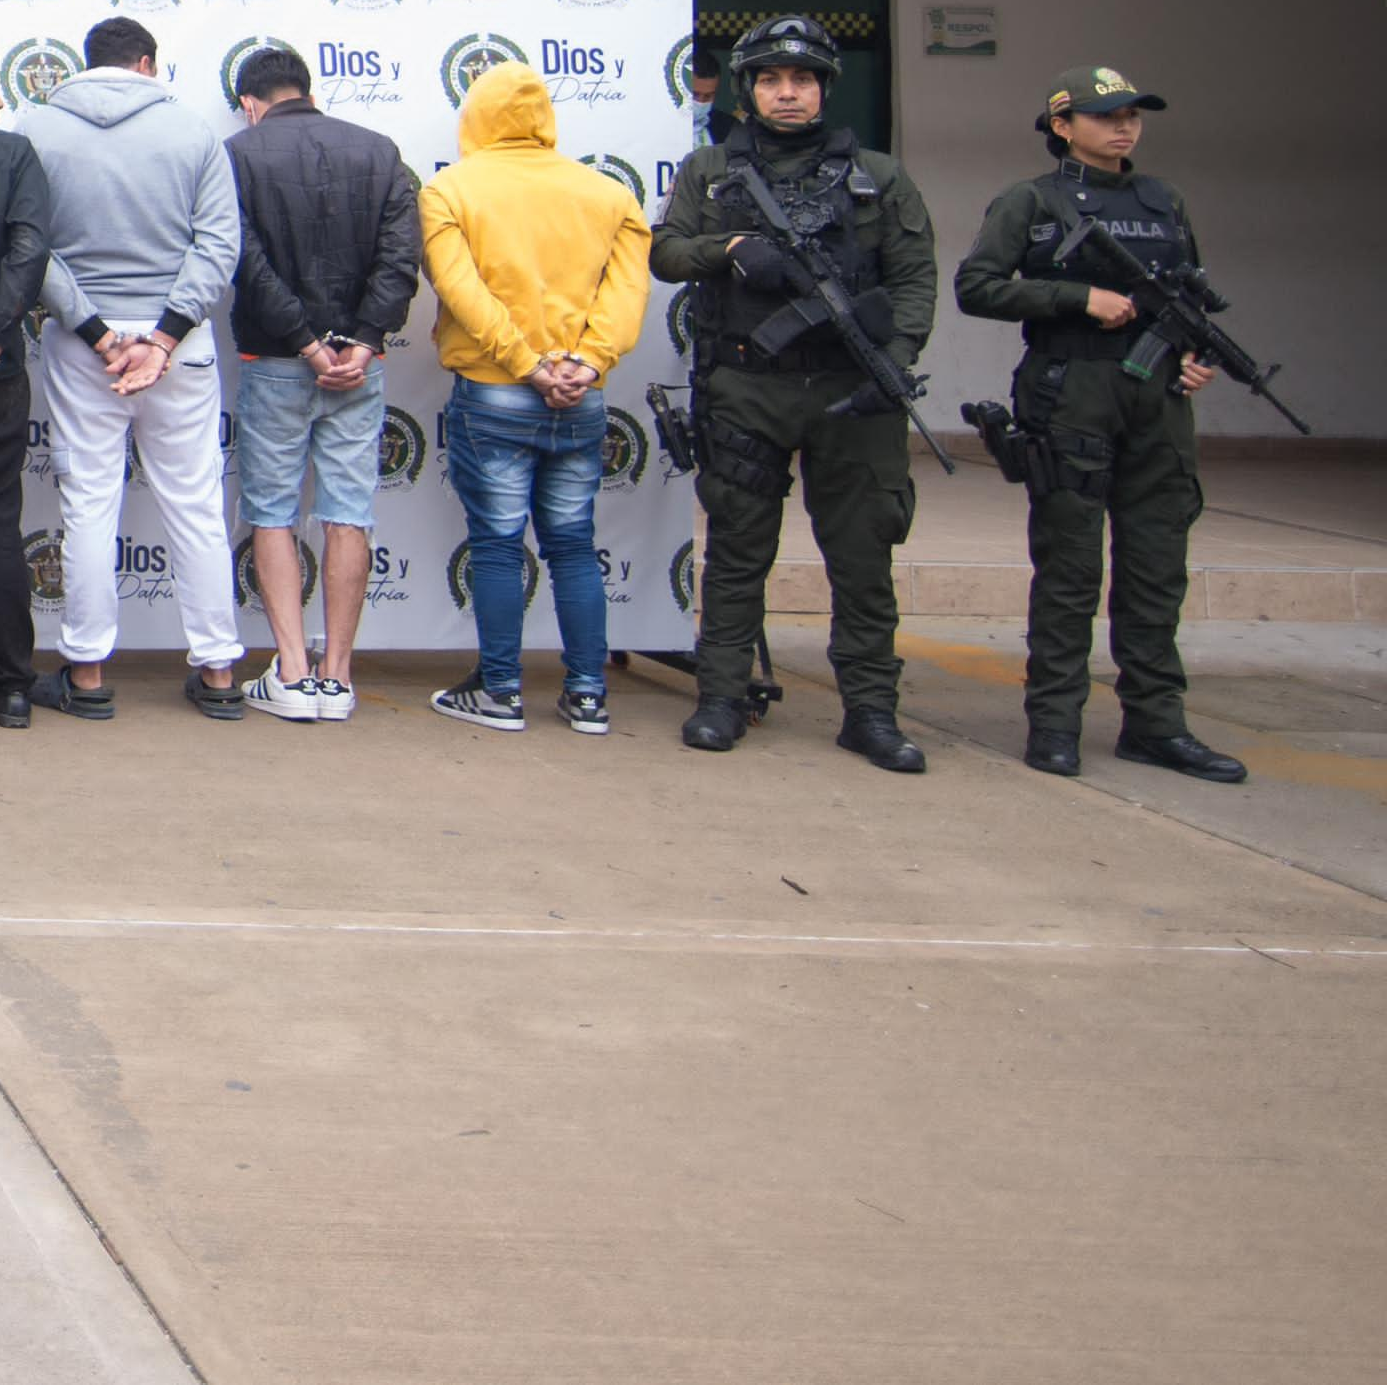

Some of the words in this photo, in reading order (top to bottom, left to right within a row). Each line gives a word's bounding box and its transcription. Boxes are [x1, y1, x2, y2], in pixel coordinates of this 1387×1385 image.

[168, 64, 176, 82] y
[319, 43, 381, 77] Dios
[391, 63, 400, 80] y
[542, 39, 605, 75] Dios
[615, 60, 624, 78] y
[323, 75, 403, 111] Patria
[399, 559, 408, 579] y
[621, 561, 631, 581] y
[364, 577, 409, 608] atria
